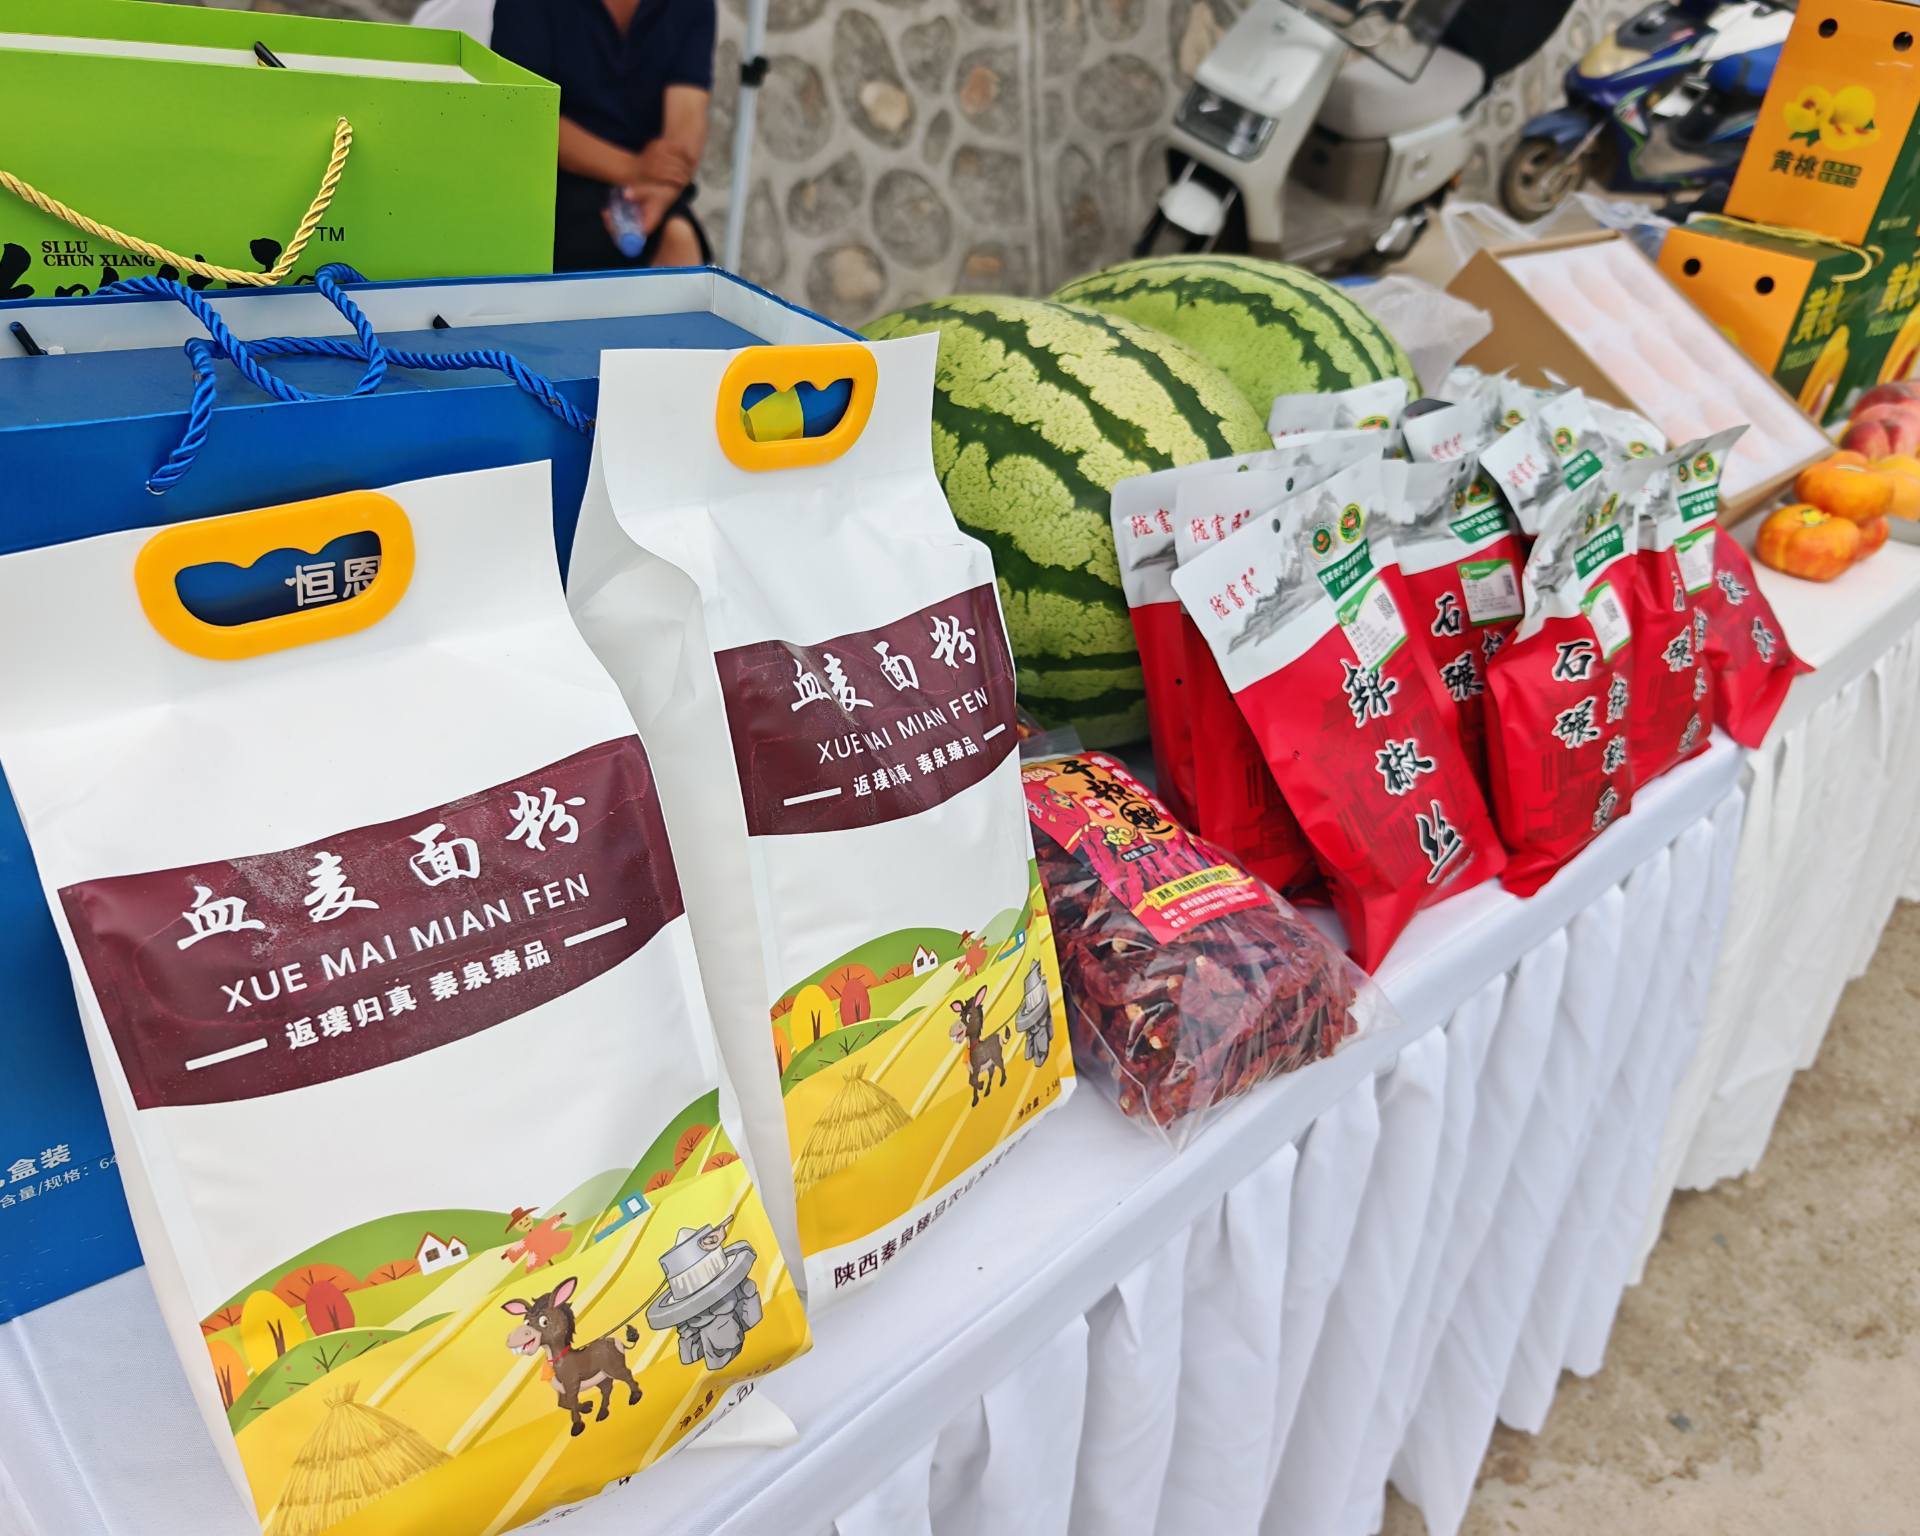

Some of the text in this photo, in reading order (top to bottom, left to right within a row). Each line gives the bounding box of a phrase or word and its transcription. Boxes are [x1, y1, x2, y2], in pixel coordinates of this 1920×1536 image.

[42, 241, 88, 253] SI LU
[43, 254, 156, 267] CHUN XIANG
[315, 227, 345, 242] TM
[1552, 638, 1602, 749] 石碾
[817, 732, 864, 765] XUE
[896, 707, 948, 740] MIAN
[948, 687, 989, 720] FEN
[916, 736, 980, 776] 秦泉臻品
[177, 787, 586, 952] 血麦面粉
[221, 873, 591, 1013] XUE MAI MIAN FEN
[285, 939, 552, 1051] 返璞归真 秦泉臻品
[0, 1143, 72, 1188] 盒装
